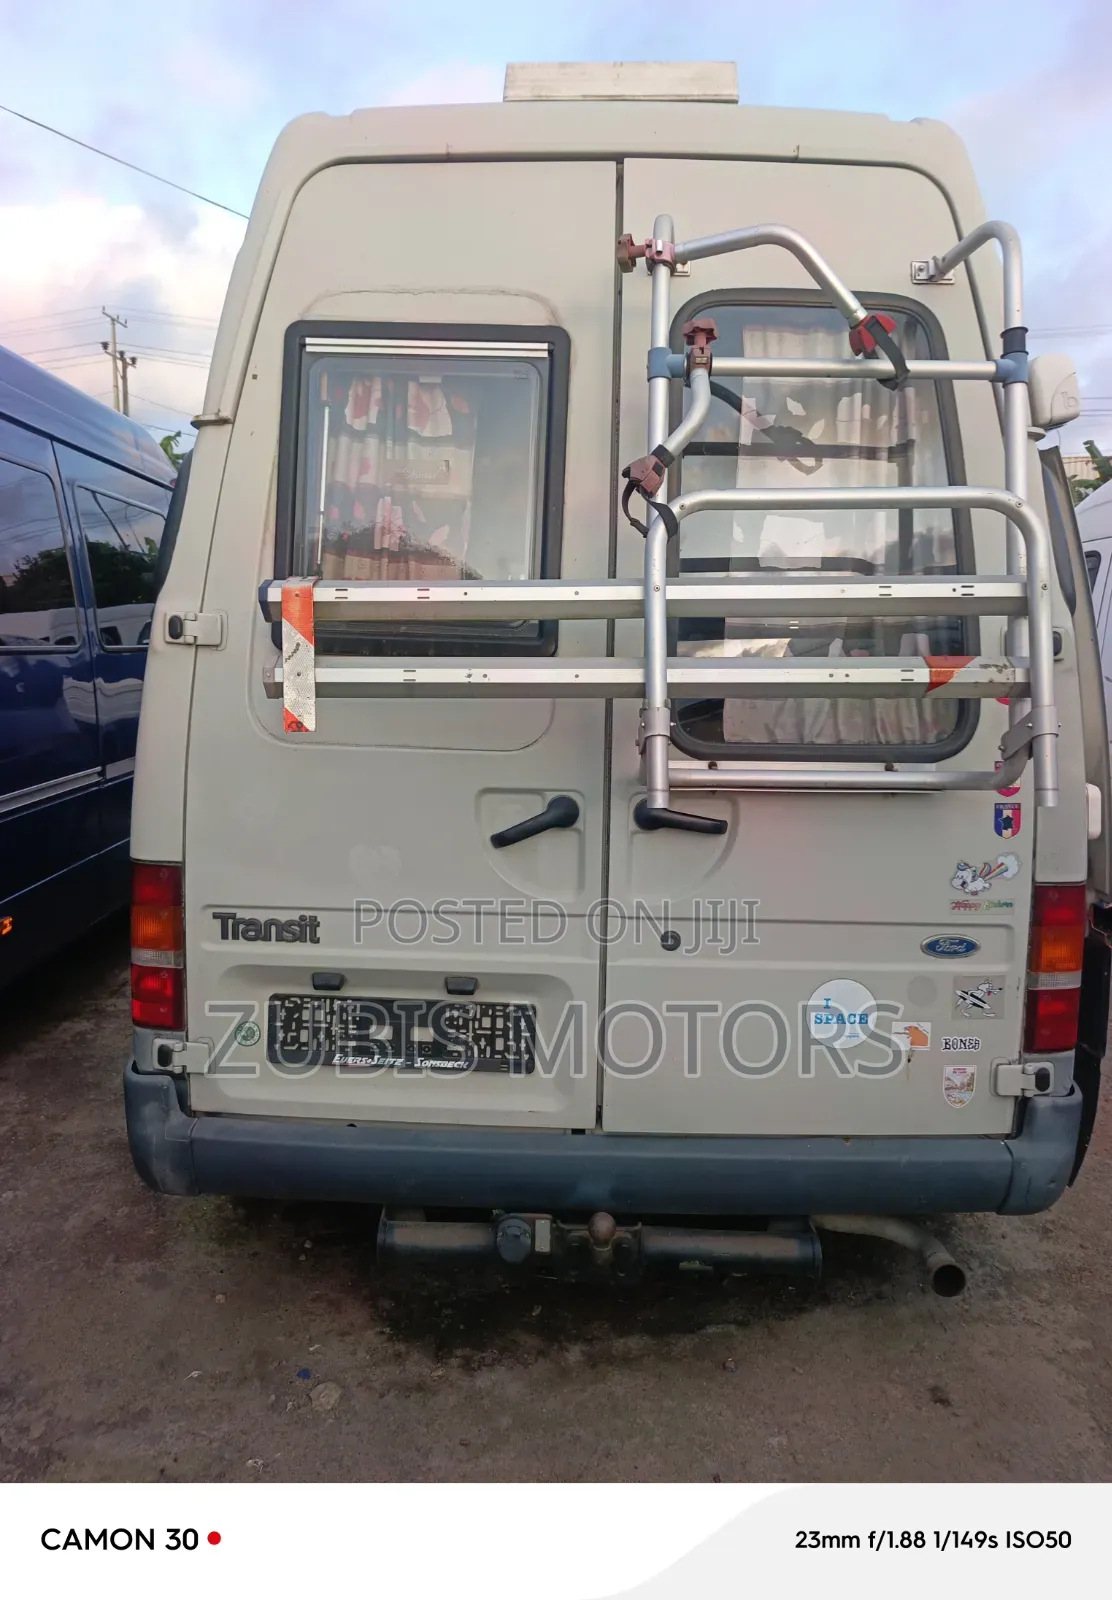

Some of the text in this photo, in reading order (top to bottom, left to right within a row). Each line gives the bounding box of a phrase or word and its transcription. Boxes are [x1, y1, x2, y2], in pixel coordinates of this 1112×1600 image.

[212, 912, 320, 944] Transit
[935, 939, 967, 952] Ford
[823, 998, 832, 1009] I
[814, 1013, 869, 1025] SPACE
